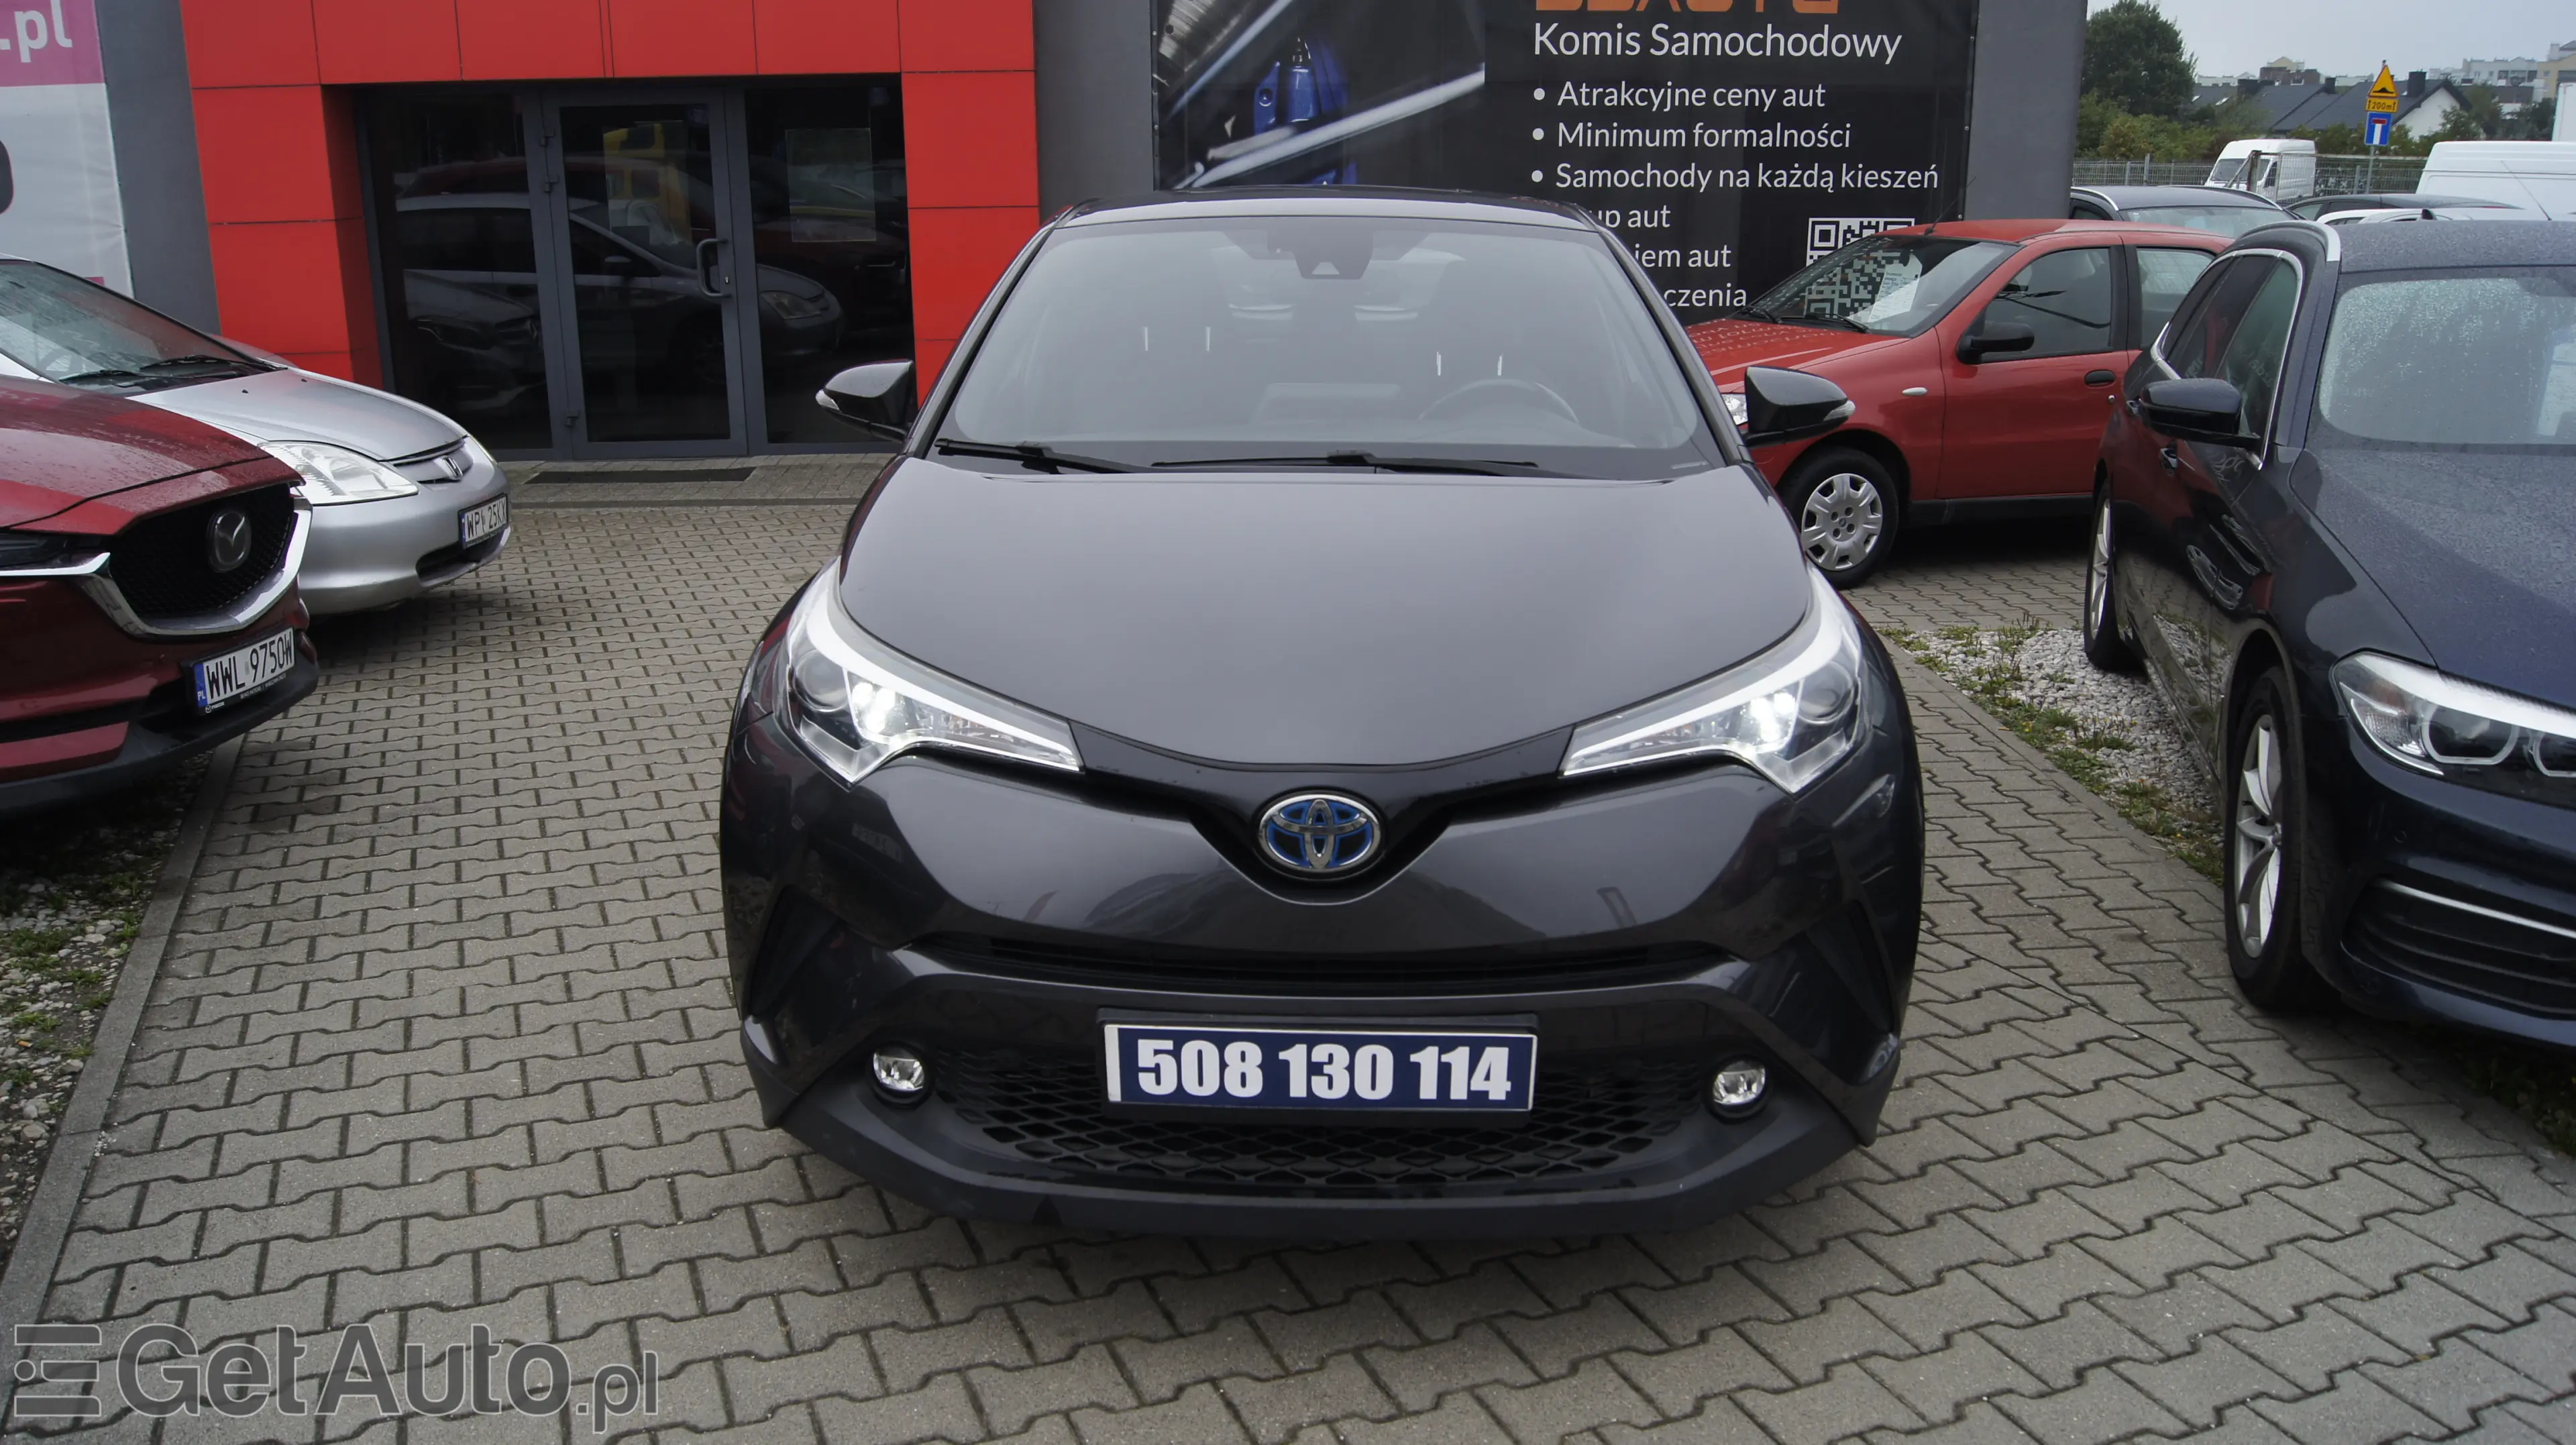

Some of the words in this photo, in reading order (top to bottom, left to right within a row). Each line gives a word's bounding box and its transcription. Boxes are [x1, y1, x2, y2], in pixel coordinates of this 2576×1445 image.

[1534, 22, 1641, 56] Komis
[1650, 23, 1902, 65] Samochodowy
[1557, 81, 1707, 112] Atrakcyjne
[1713, 87, 1777, 113] ceny
[1782, 84, 1826, 107] aut
[2372, 101, 2393, 111] 200m
[1558, 121, 1686, 148] Minimum
[1693, 121, 1851, 148] formalności
[1555, 162, 1713, 193] Samochody
[1719, 168, 1750, 188] na
[1757, 162, 1835, 193] każdą
[1840, 163, 1939, 189] kieszeń
[1627, 205, 1671, 228] aut
[1688, 245, 1732, 268] aut
[206, 655, 246, 700] WWL
[197, 691, 207, 702] PL
[1138, 1038, 1264, 1097] 508
[1278, 1042, 1394, 1101] 130
[1409, 1045, 1512, 1101] 114
